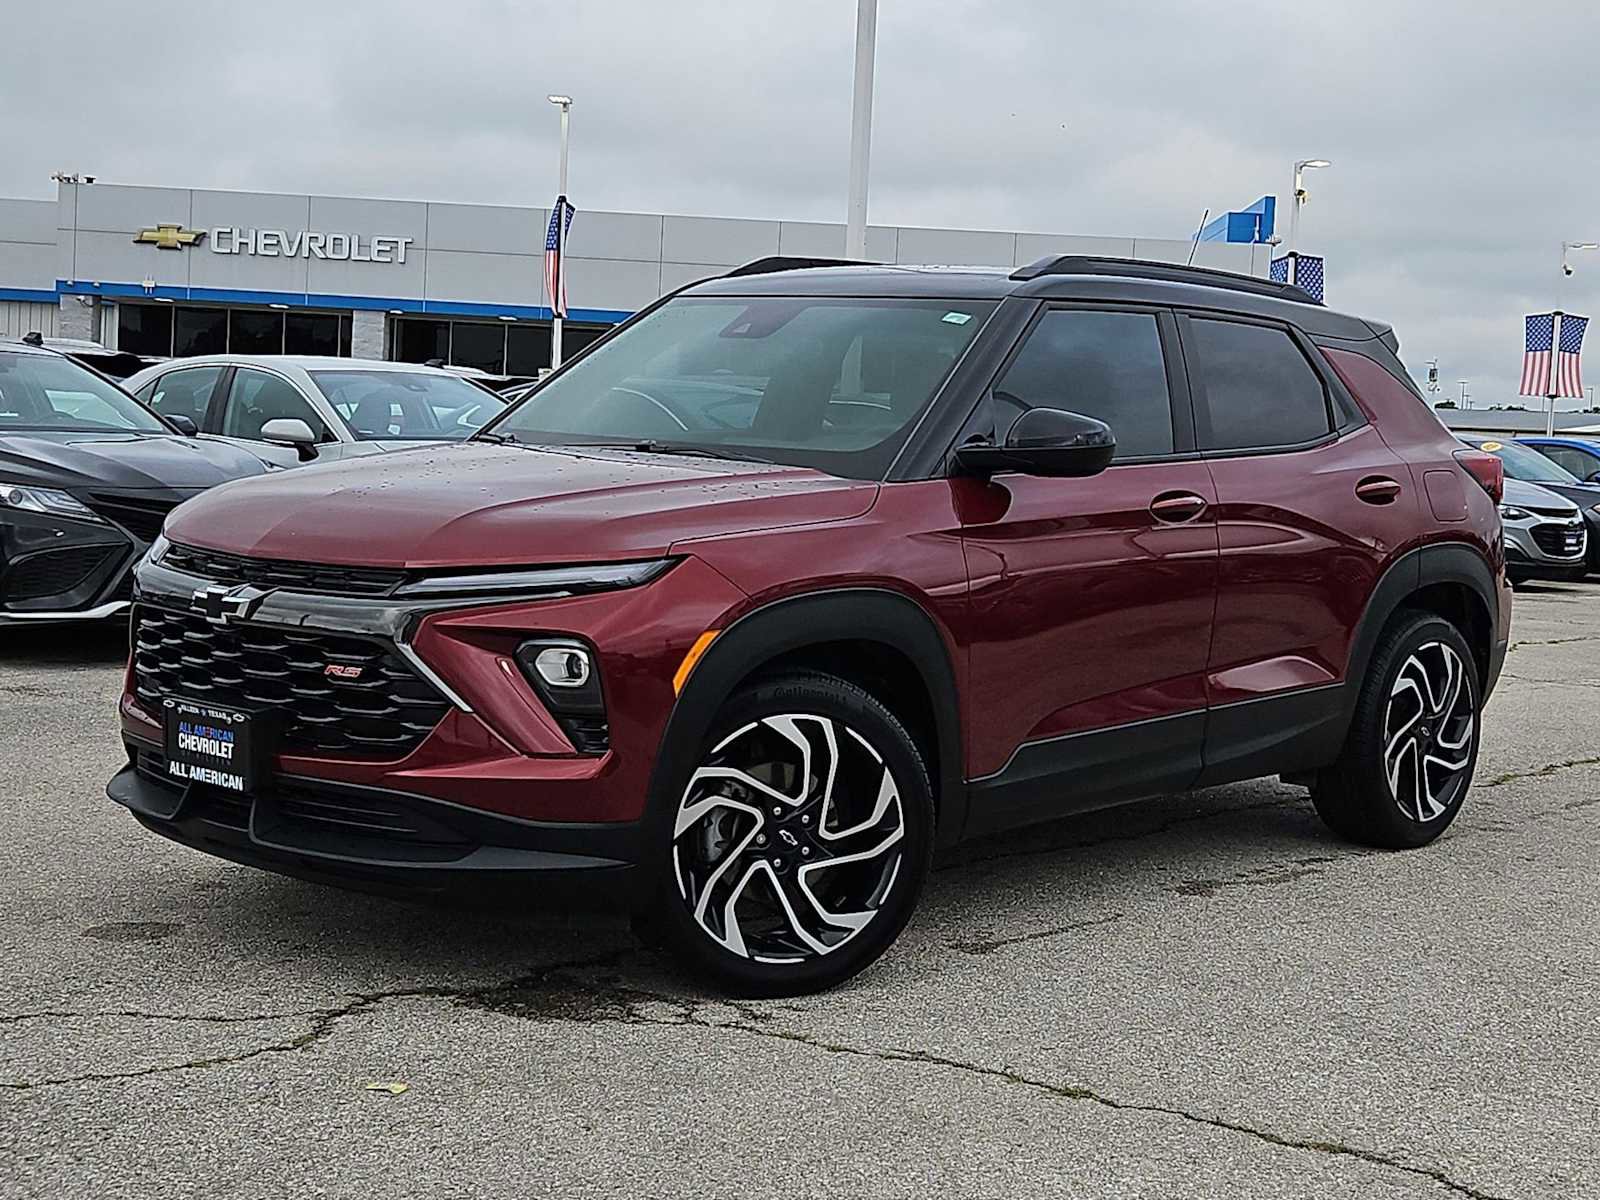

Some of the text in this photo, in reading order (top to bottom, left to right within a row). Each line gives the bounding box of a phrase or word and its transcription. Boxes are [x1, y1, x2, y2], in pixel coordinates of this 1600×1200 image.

[210, 227, 413, 264] CHEVROLET
[324, 665, 362, 678] RS
[208, 709, 227, 720] TEXAS
[178, 721, 234, 743] ALL AMERICAN
[178, 732, 235, 759] CHEVROLET
[169, 761, 243, 791] ALL AMERICAN
